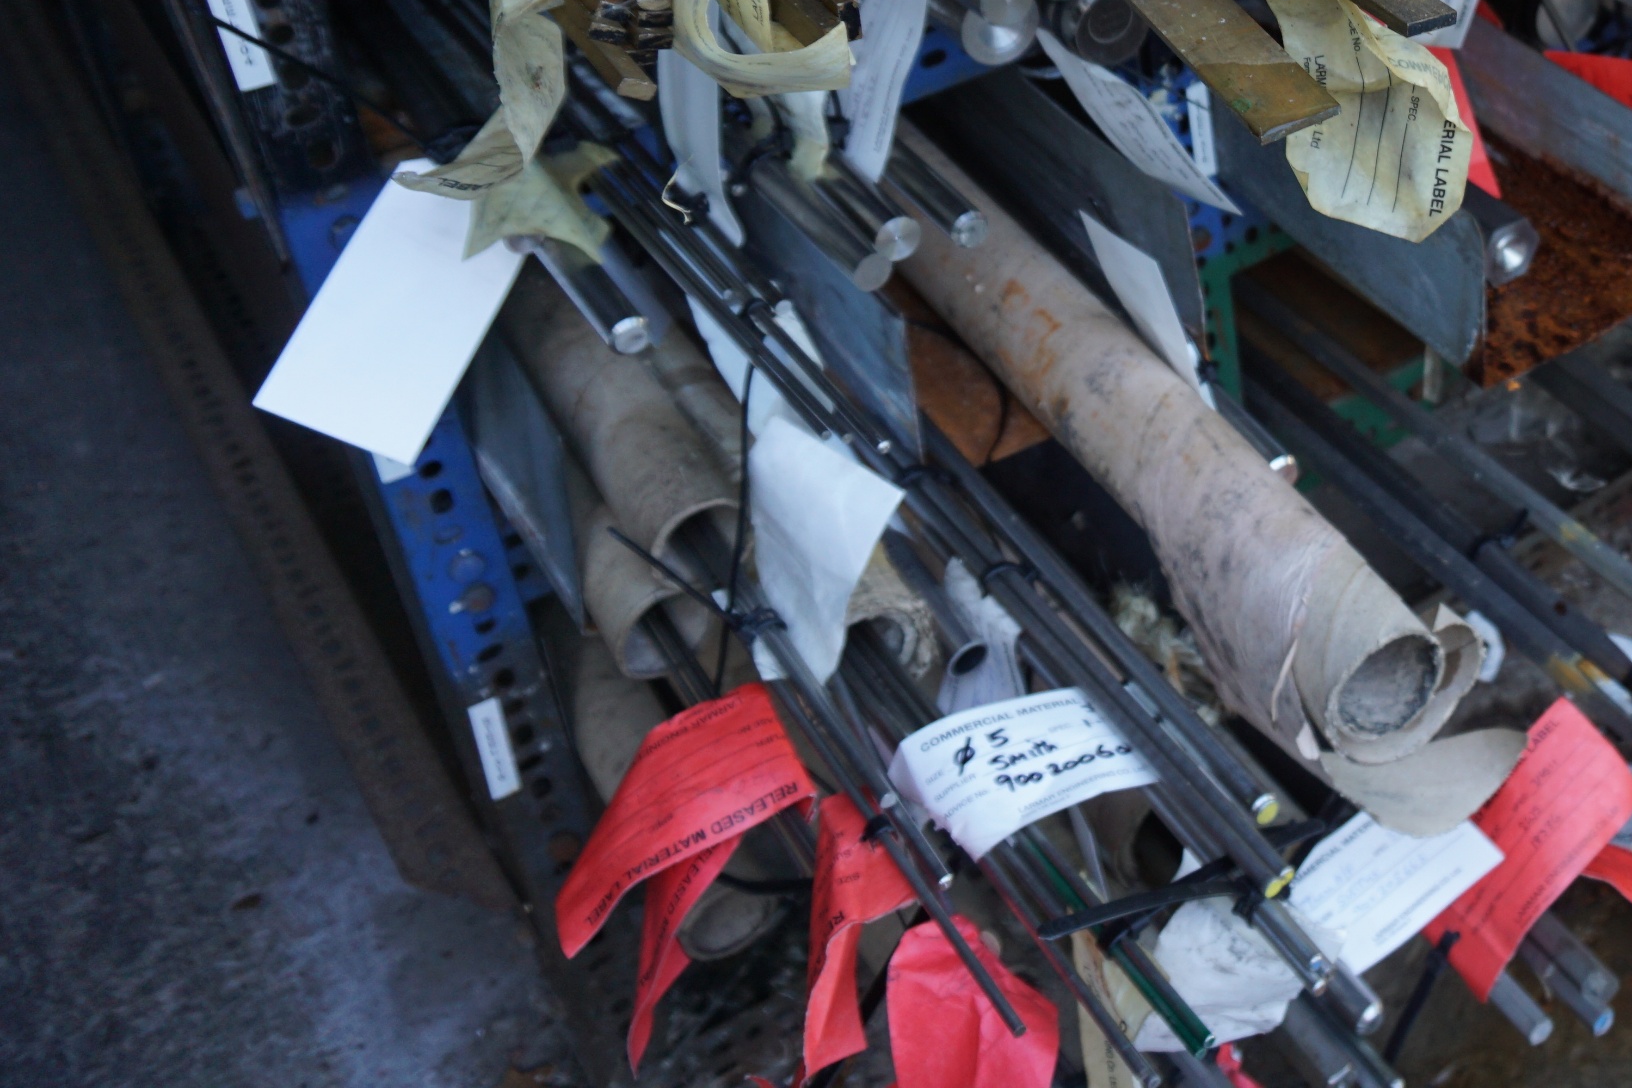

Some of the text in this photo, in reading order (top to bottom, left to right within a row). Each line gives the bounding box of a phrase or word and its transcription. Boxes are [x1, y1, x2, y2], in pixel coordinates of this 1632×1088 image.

[1351, 37, 1361, 53] No.
[1310, 54, 1328, 151] LARM Ltd
[1407, 95, 1421, 123] SPEC.
[1428, 119, 1457, 218] ERIAL LABEL
[920, 697, 1080, 754] COMMERCIAL MATERIAL
[986, 727, 1010, 749] 5
[1527, 719, 1561, 754] LABEL
[925, 768, 944, 786] SIZE
[934, 772, 977, 802] SUPPLIER
[944, 794, 975, 818] ADVICE
[584, 781, 798, 928] RELEASED MATERIAL LABEL
